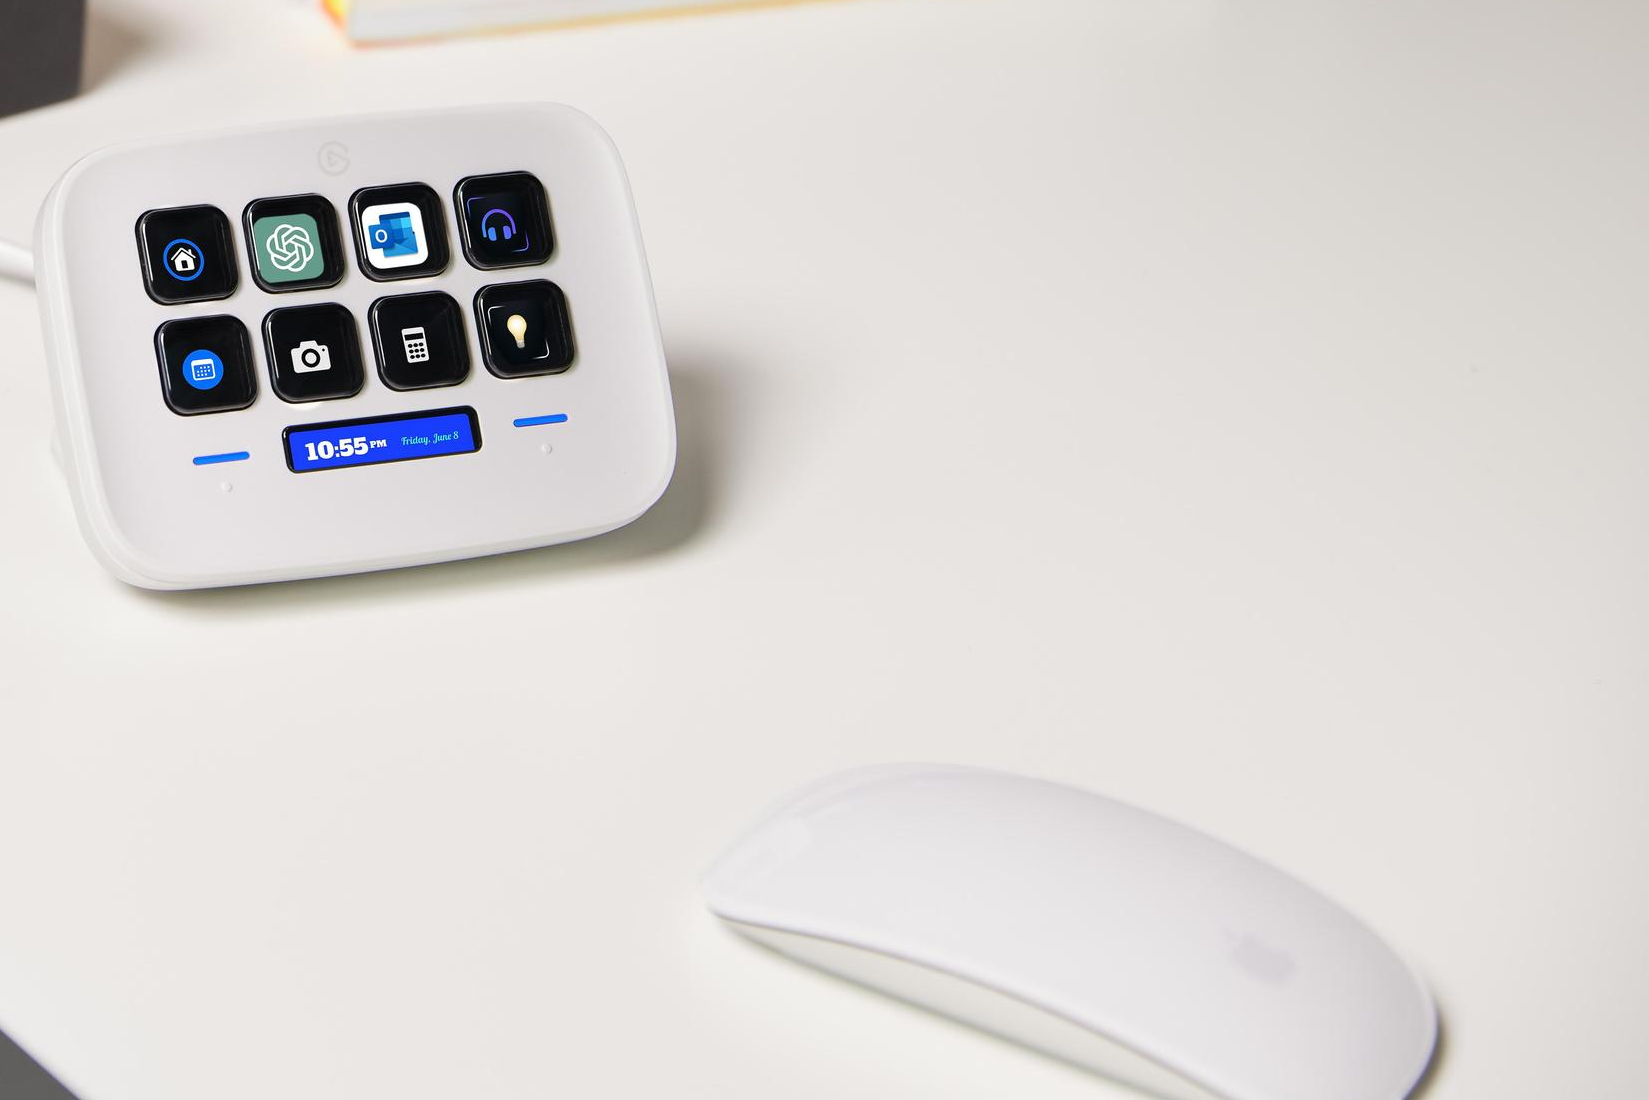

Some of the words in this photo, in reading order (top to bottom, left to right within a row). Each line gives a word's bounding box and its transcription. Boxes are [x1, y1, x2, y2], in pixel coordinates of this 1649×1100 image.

[304, 436, 369, 461] 10:55
[370, 438, 388, 450] PM
[433, 432, 452, 444] June
[453, 431, 459, 440] 8
